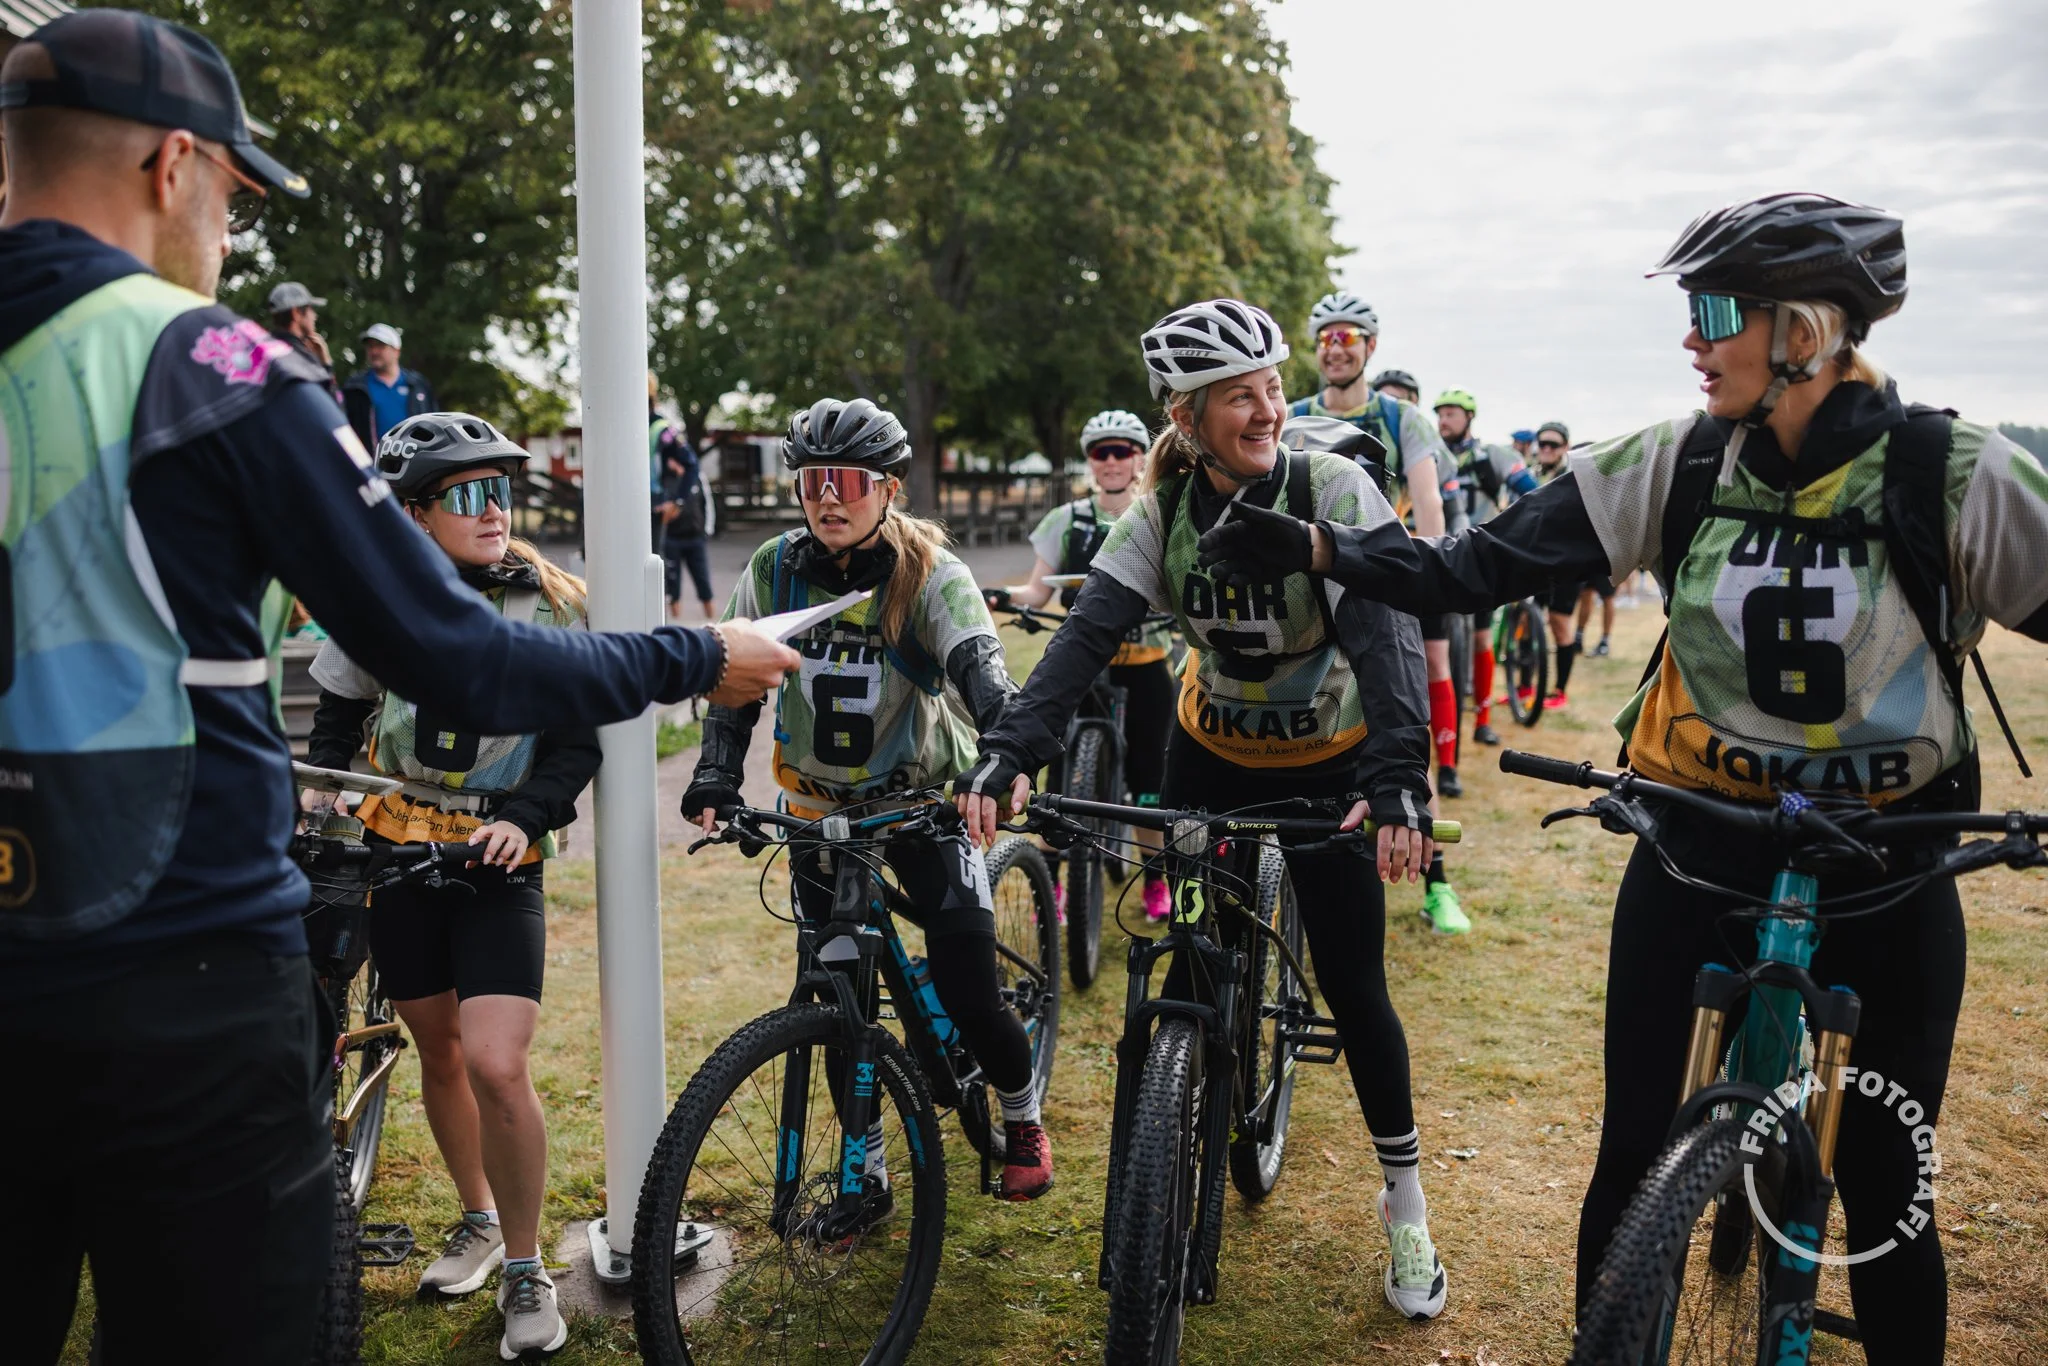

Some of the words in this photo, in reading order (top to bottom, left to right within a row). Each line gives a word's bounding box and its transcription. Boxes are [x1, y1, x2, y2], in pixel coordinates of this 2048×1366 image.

[1171, 349, 1212, 358] SCOTT
[1687, 456, 1714, 465] OSPREY
[1742, 586, 1846, 724] 6
[812, 673, 875, 767] 6
[1695, 734, 1911, 794] JOKAB
[881, 1053, 922, 1112] KENDATIRE.COM
[841, 1134, 867, 1194] FOX
